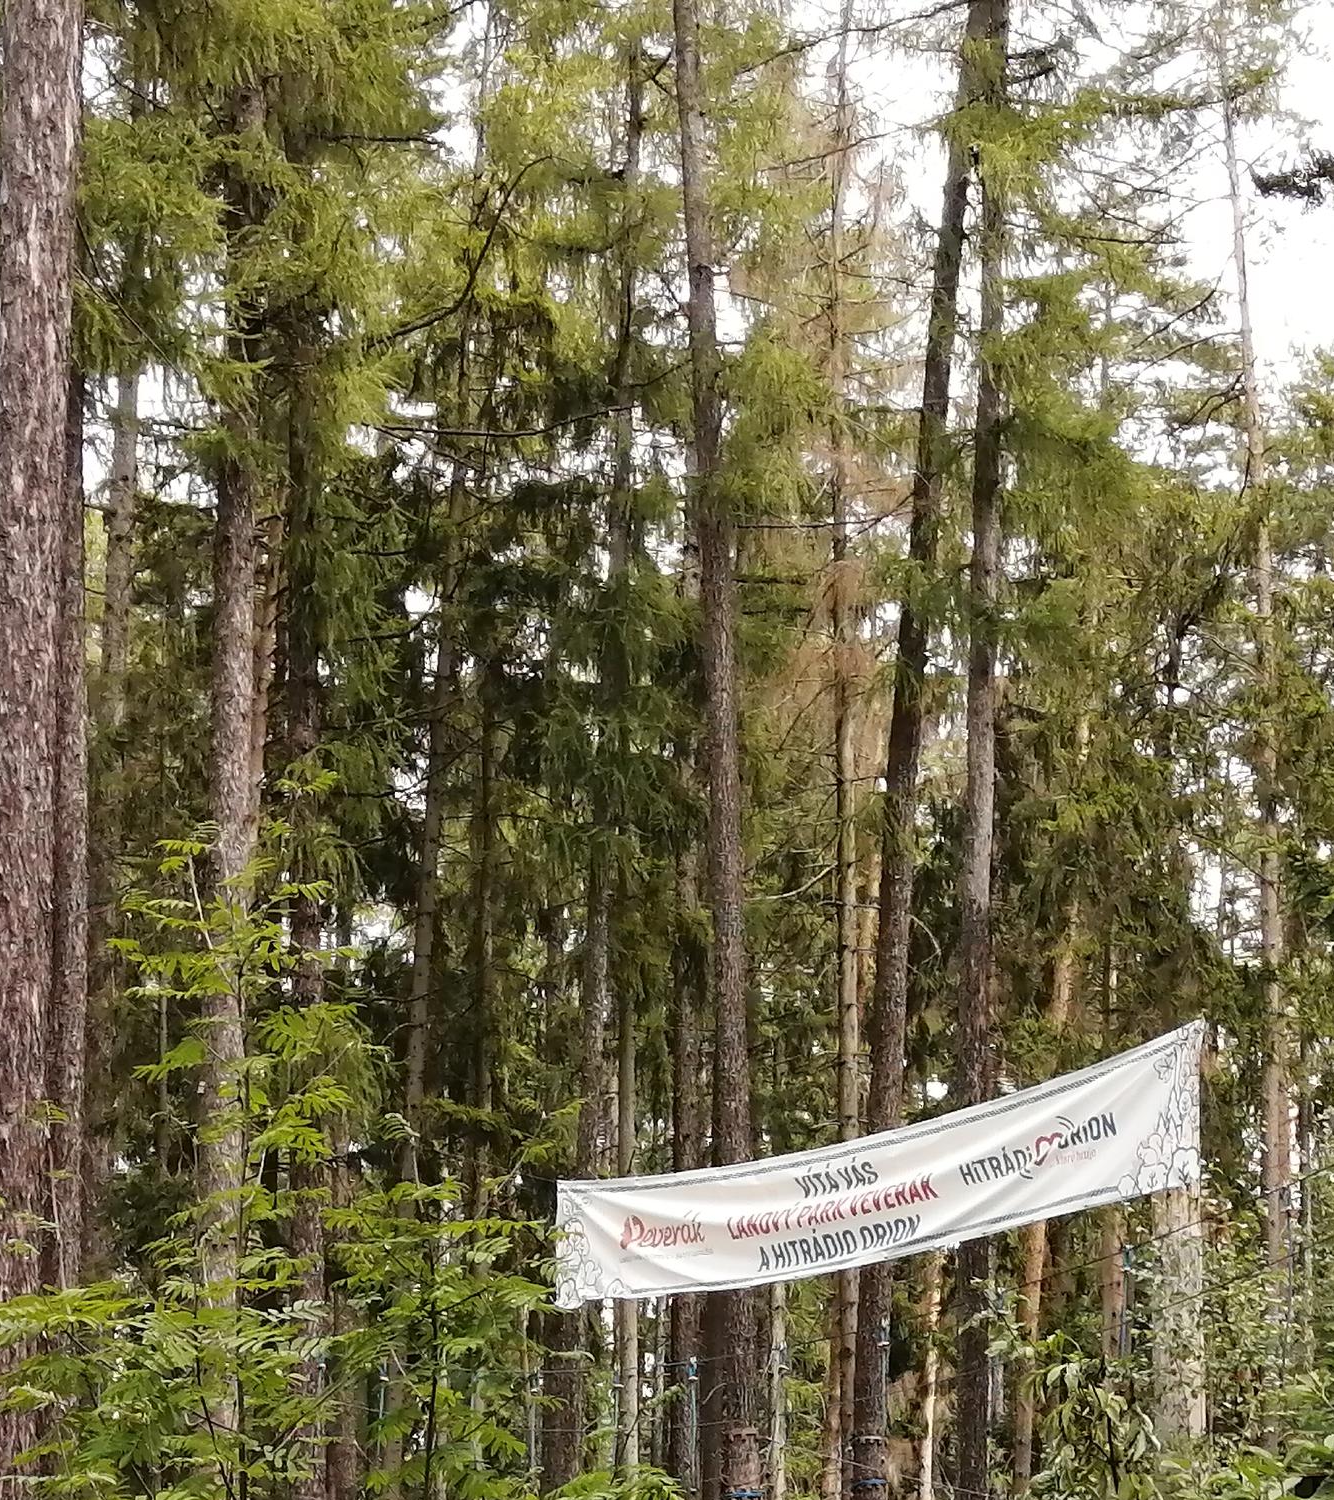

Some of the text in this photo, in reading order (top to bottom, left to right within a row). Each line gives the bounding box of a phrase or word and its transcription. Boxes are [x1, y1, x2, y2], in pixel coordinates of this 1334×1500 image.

[727, 1172, 940, 1240] LANOVÝ PARK VEVERÁK
[794, 1156, 879, 1199] VÍTÁ VÁS
[757, 1245, 771, 1273] A
[770, 1227, 858, 1270] HITRÁDIO
[859, 1213, 922, 1252] ORION
